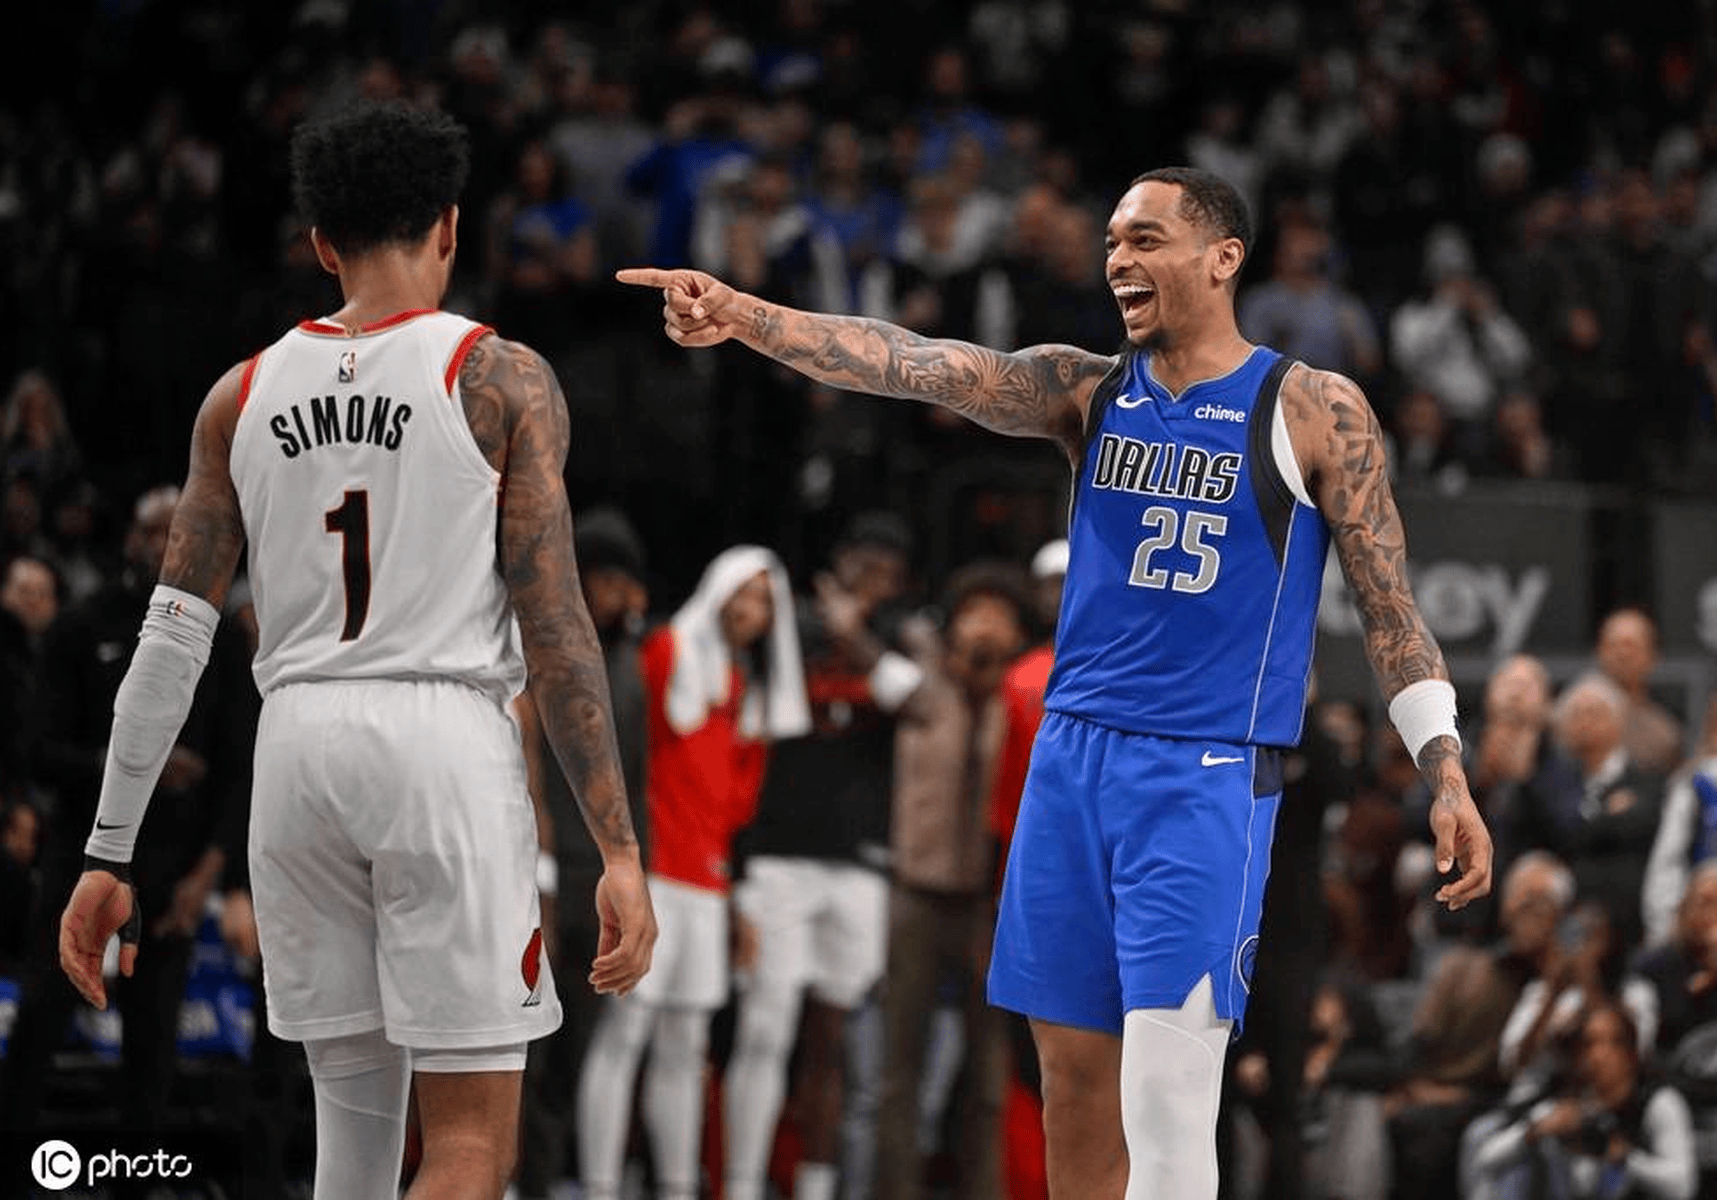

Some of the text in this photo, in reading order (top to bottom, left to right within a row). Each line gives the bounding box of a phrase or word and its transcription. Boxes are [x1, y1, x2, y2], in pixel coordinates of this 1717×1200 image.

[269, 395, 412, 459] SIMONS
[1194, 403, 1246, 423] chime
[1092, 433, 1243, 504] DALLAS
[325, 490, 371, 643] 1
[1128, 506, 1228, 594] 25
